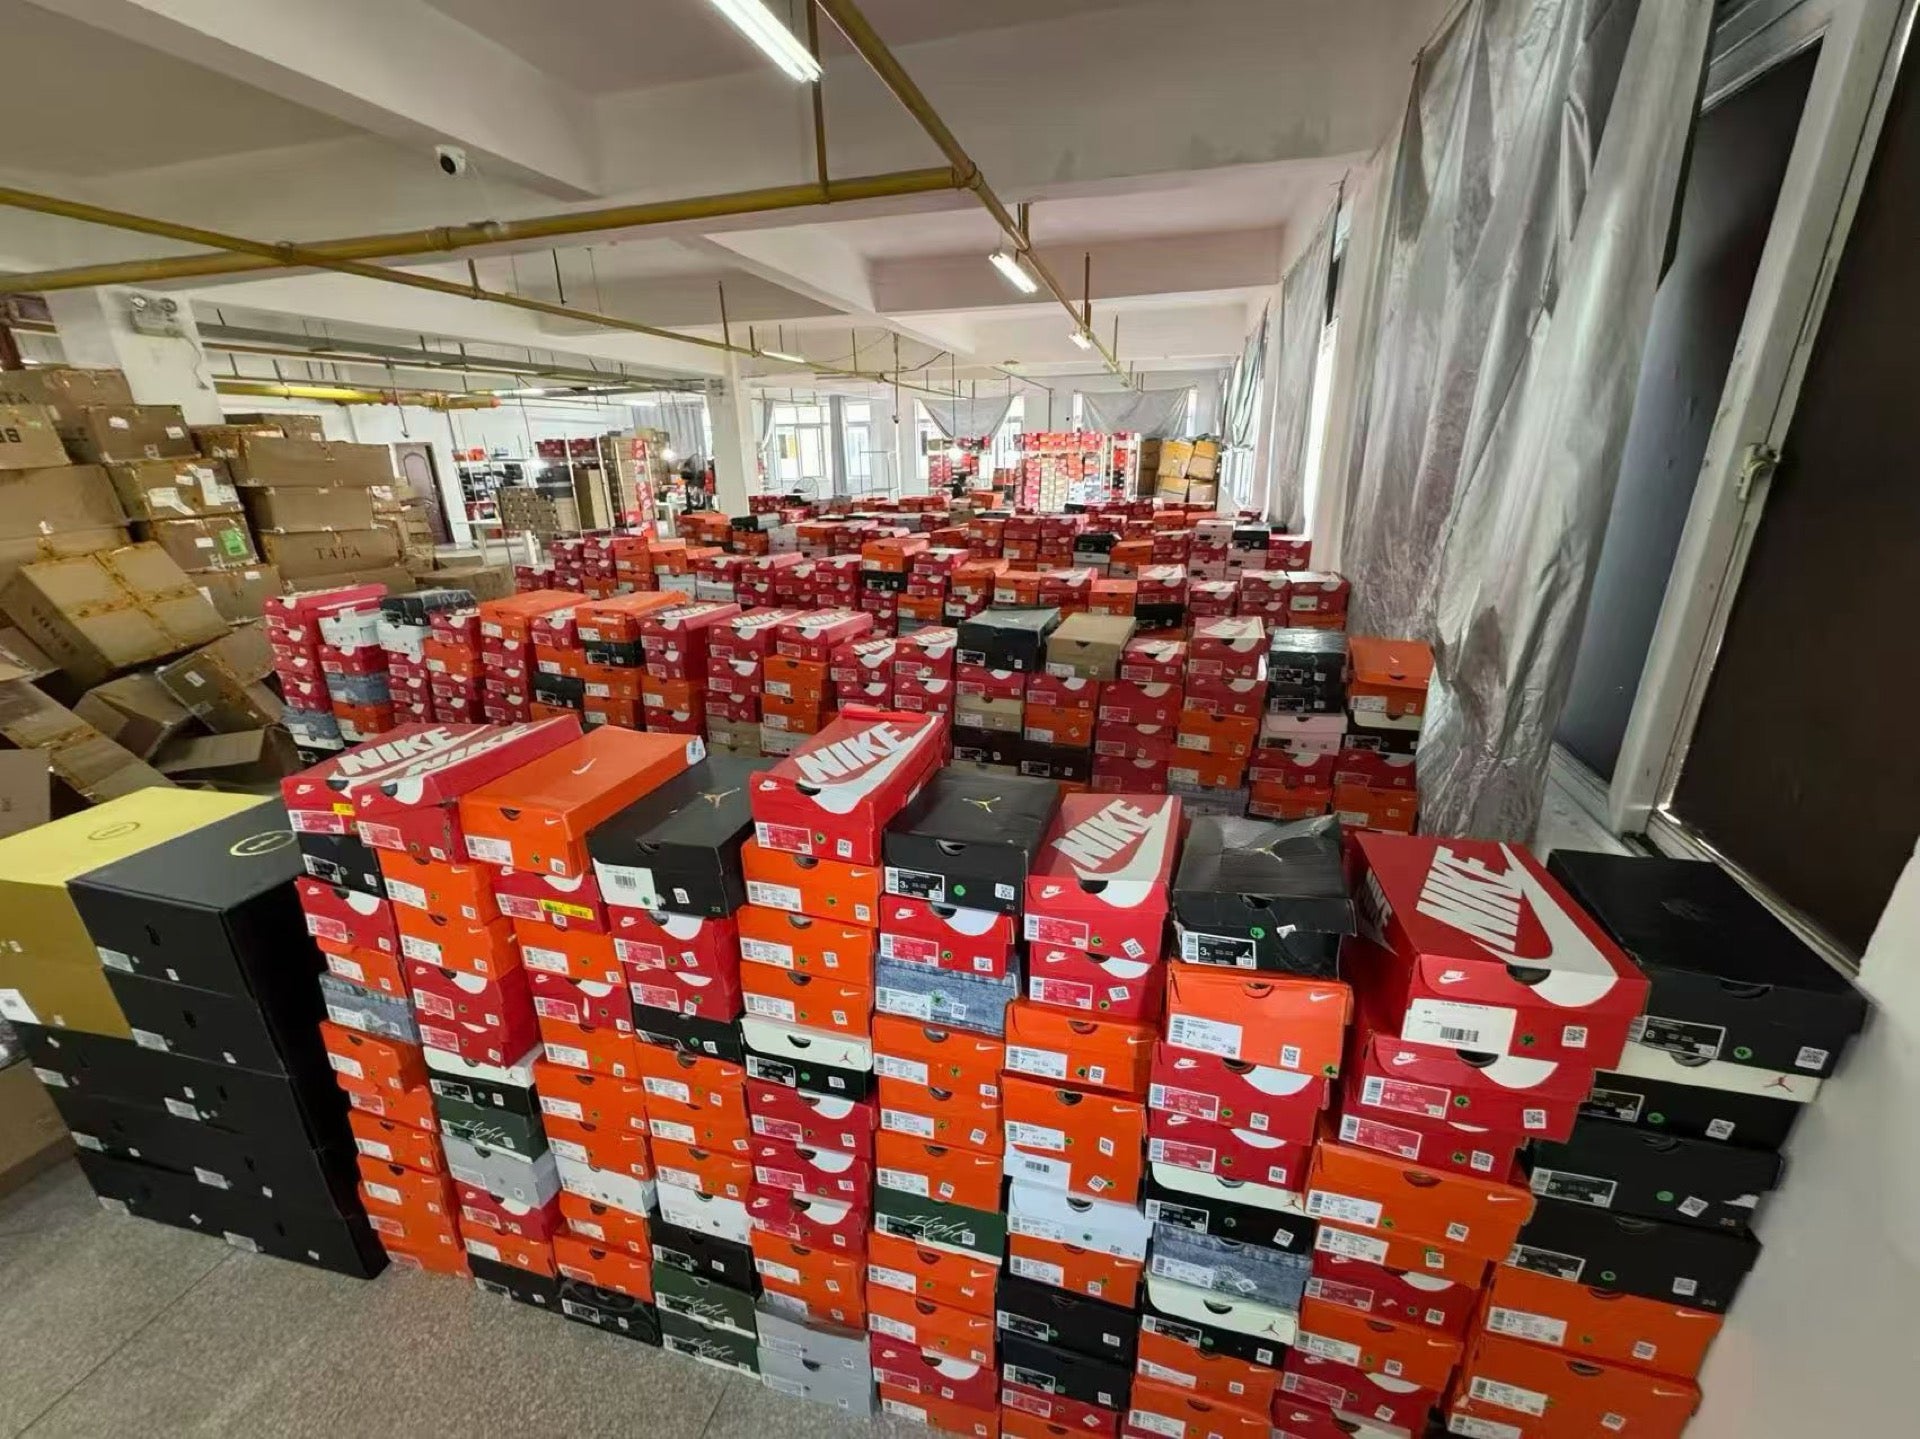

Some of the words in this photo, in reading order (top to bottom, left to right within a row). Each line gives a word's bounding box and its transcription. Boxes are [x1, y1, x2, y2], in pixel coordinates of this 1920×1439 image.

[315, 546, 361, 559] TATA
[337, 726, 452, 775] NIKE
[404, 725, 529, 777] NIKE
[795, 722, 910, 783] NIKE
[1051, 799, 1160, 870] NIKE
[1416, 846, 1522, 953] NIKE
